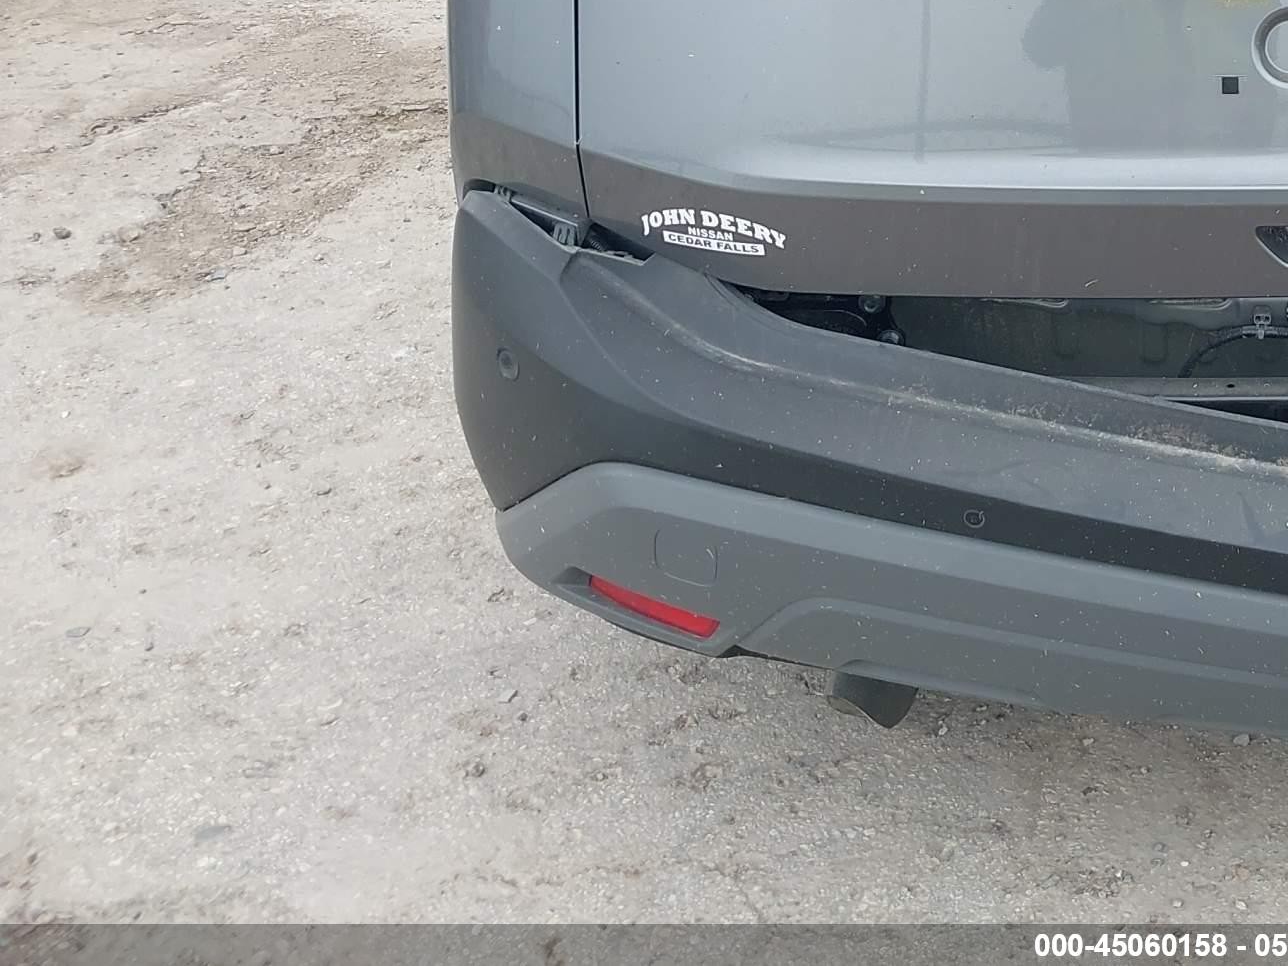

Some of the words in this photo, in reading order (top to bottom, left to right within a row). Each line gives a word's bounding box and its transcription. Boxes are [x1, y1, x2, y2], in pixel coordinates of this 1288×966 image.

[641, 208, 696, 236] JOHN
[700, 210, 786, 249] DEERY
[687, 226, 734, 241] NISSAN
[668, 234, 712, 248] CEDAR
[716, 241, 759, 253] FALLS
